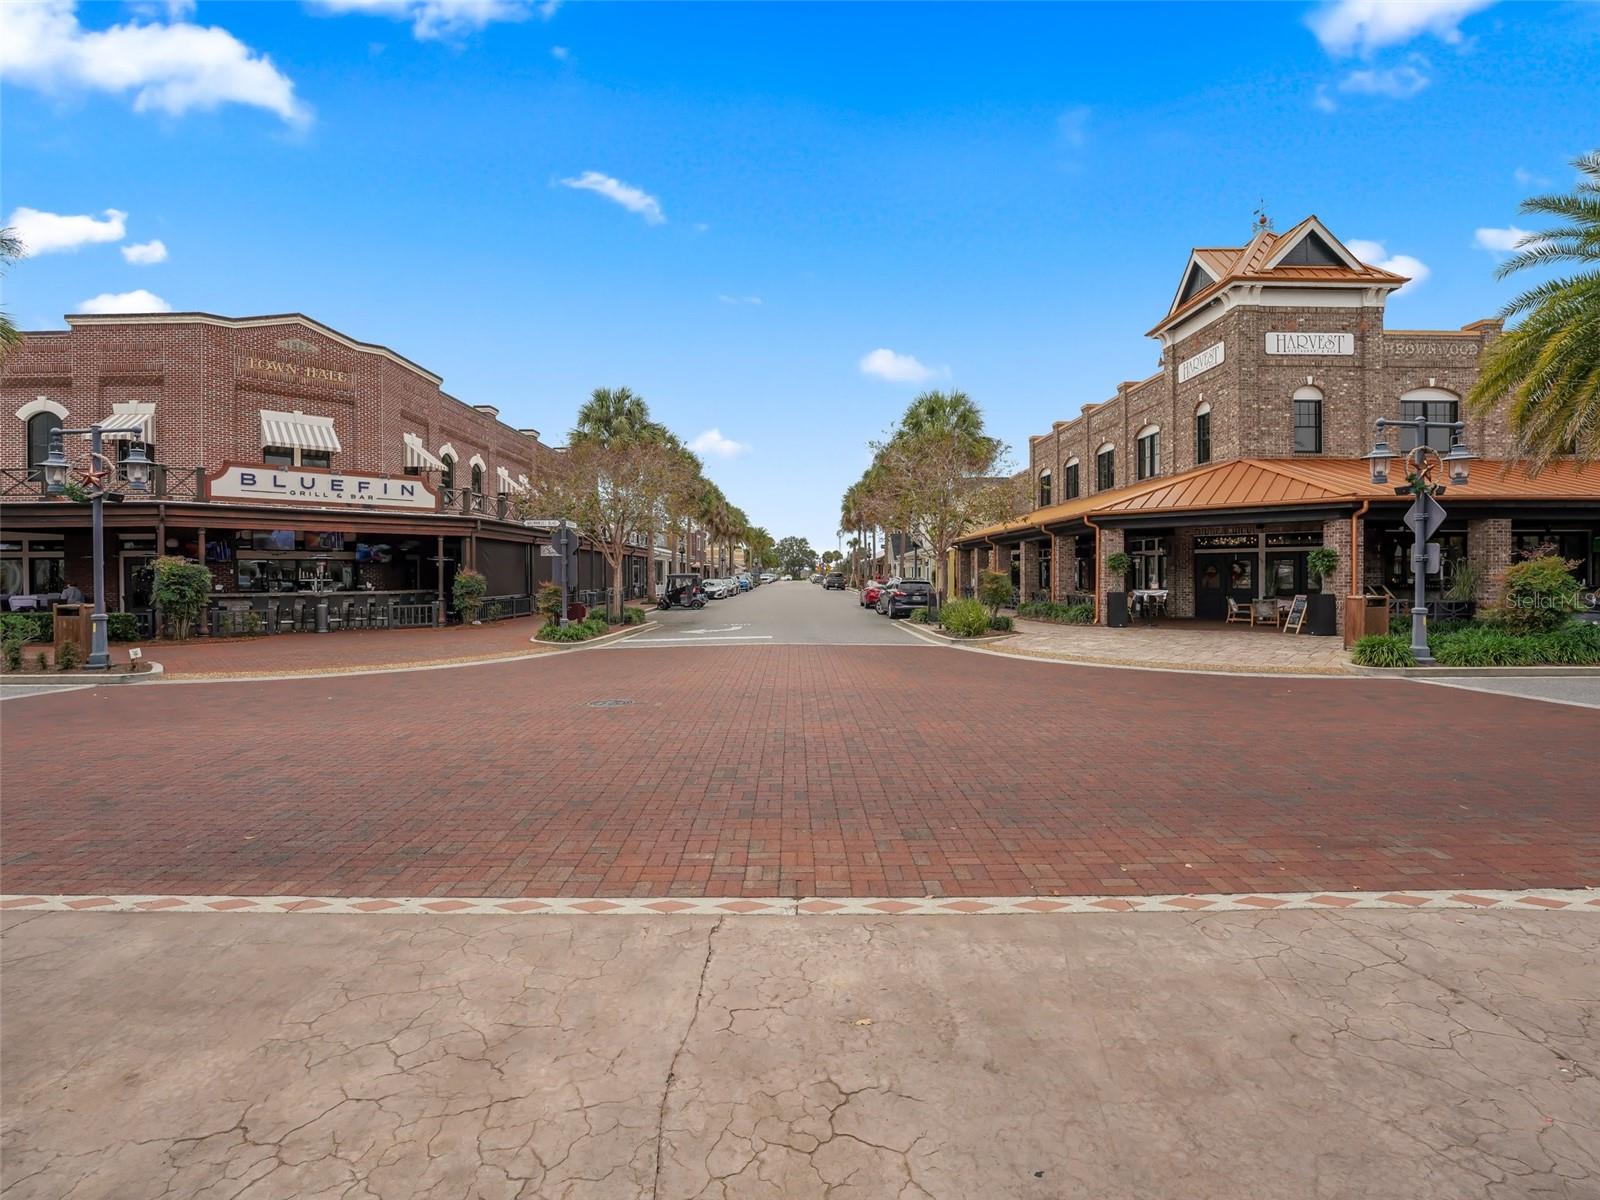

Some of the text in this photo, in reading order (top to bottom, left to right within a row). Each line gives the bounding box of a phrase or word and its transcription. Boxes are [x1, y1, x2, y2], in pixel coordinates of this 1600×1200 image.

[1276, 334, 1345, 354] HARVEST
[246, 357, 297, 374] TOWN
[240, 472, 415, 496] BLUEFIN
[289, 489, 328, 498] GRILL
